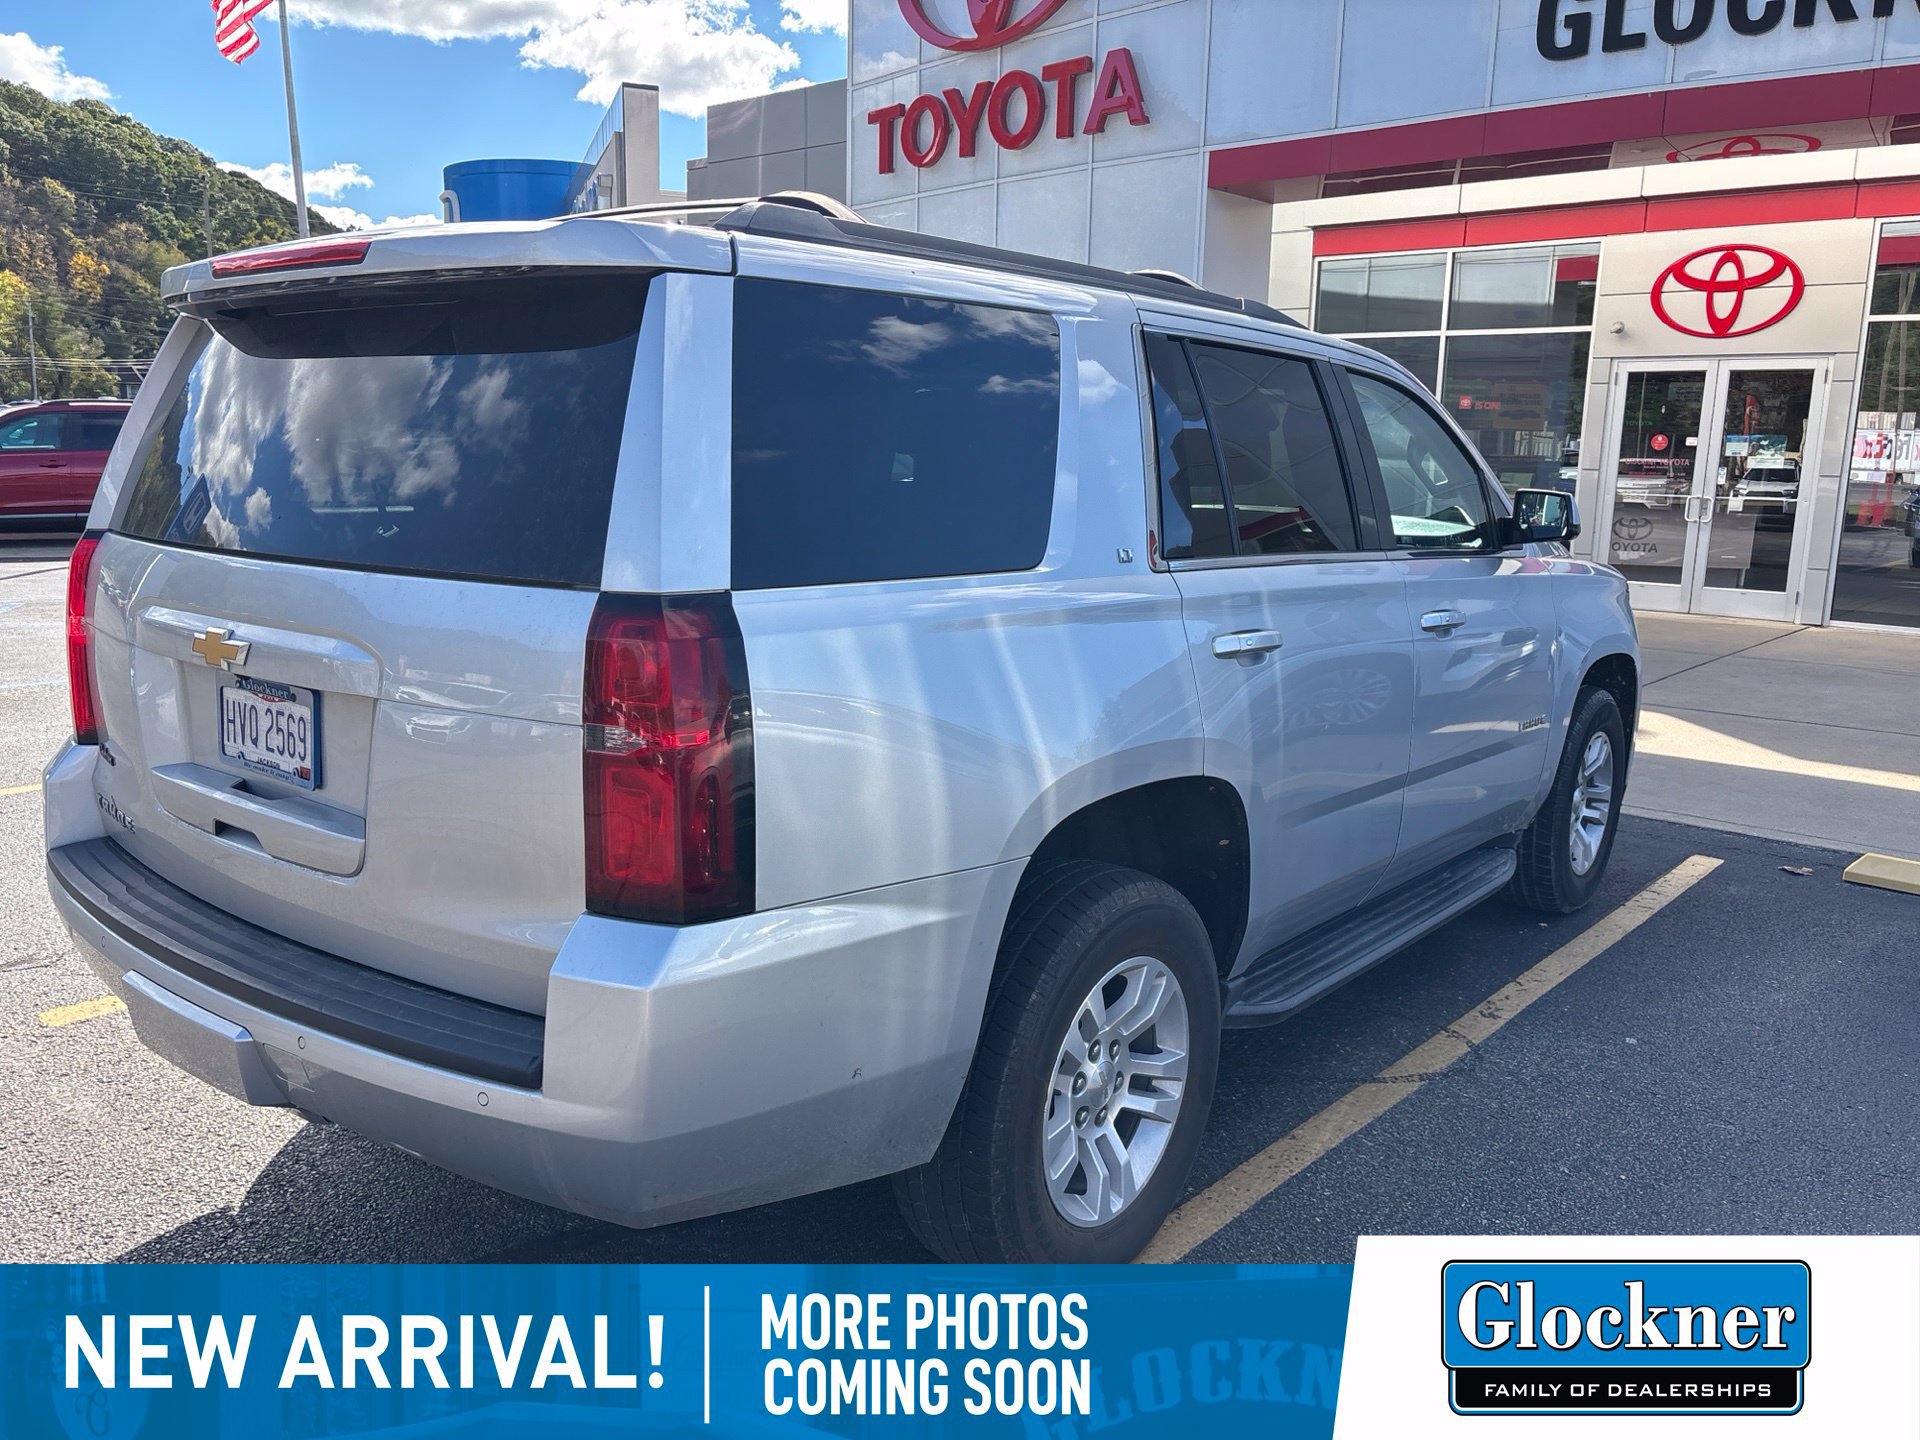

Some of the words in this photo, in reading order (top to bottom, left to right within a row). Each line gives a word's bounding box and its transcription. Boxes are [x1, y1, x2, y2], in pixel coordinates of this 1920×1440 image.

[1536, 0, 1920, 62] GLO
[867, 47, 1150, 175] TOYOTA
[1611, 541, 1658, 553] OYOTA
[242, 678, 290, 699] Glockner
[226, 698, 259, 748] HVQ
[265, 707, 306, 761] 2569
